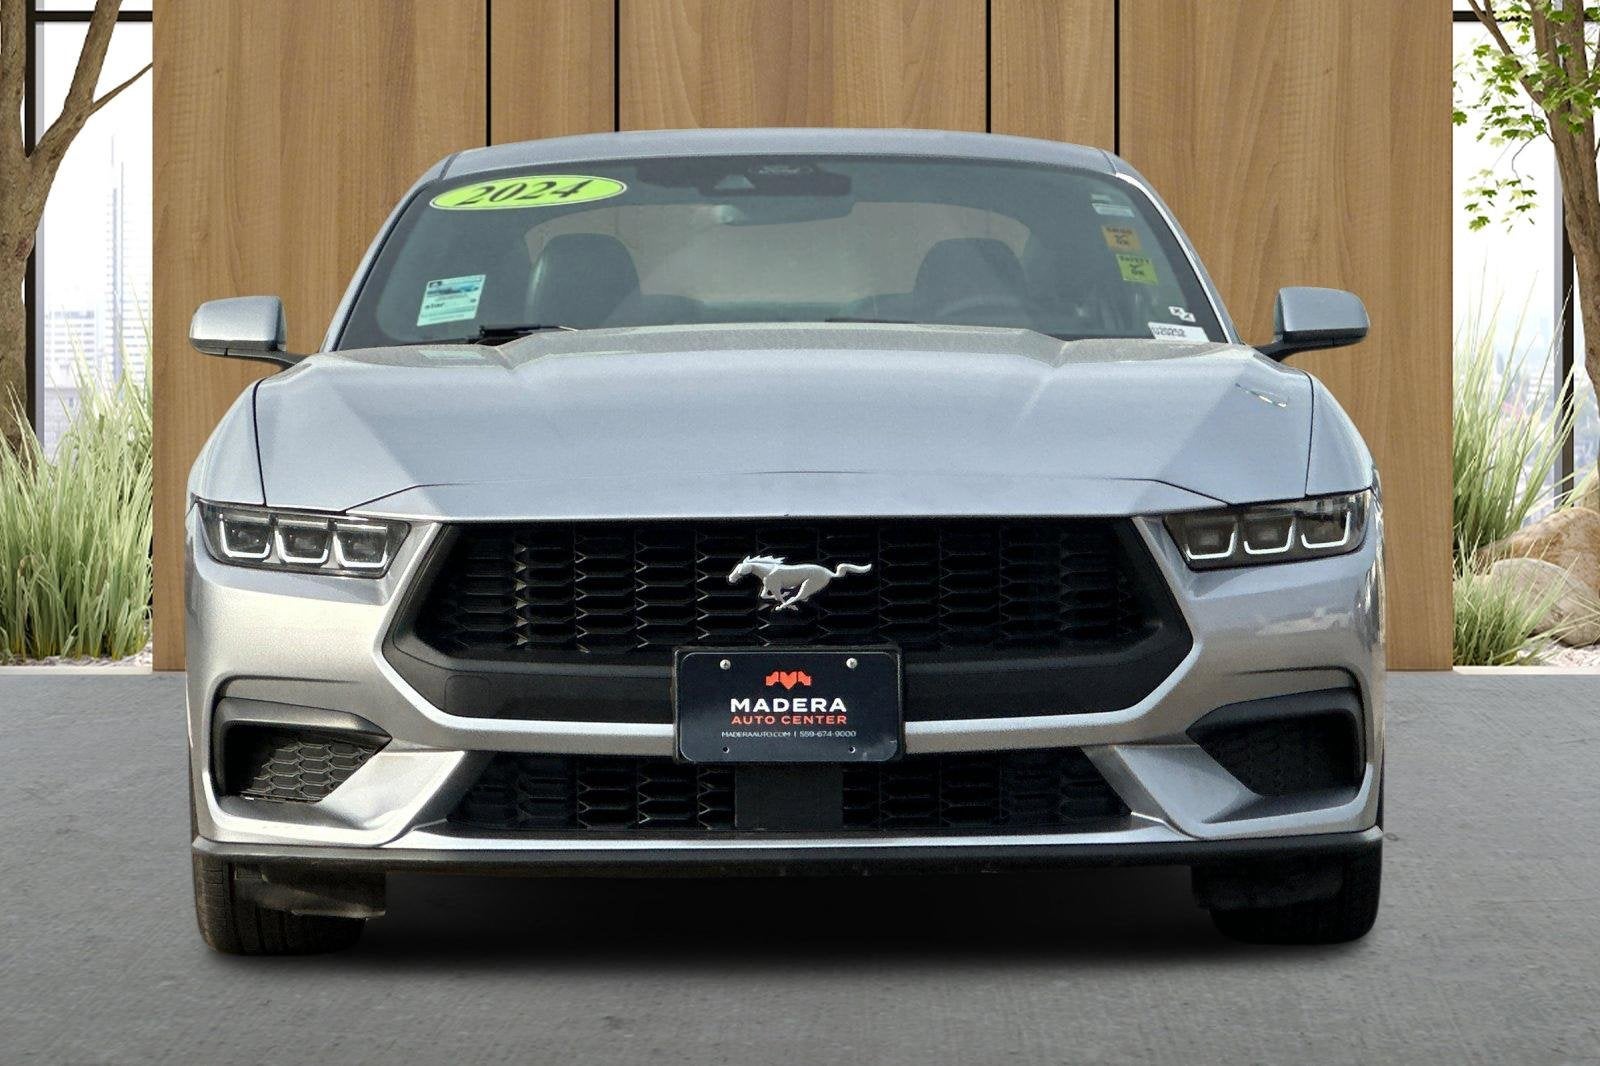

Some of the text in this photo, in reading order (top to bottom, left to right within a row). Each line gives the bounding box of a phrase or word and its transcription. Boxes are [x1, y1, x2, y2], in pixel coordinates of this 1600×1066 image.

[454, 178, 595, 206] 2024
[730, 698, 847, 713] MADERA
[731, 715, 847, 725] AUTO CENTER
[799, 730, 857, 738] 559-674-9000
